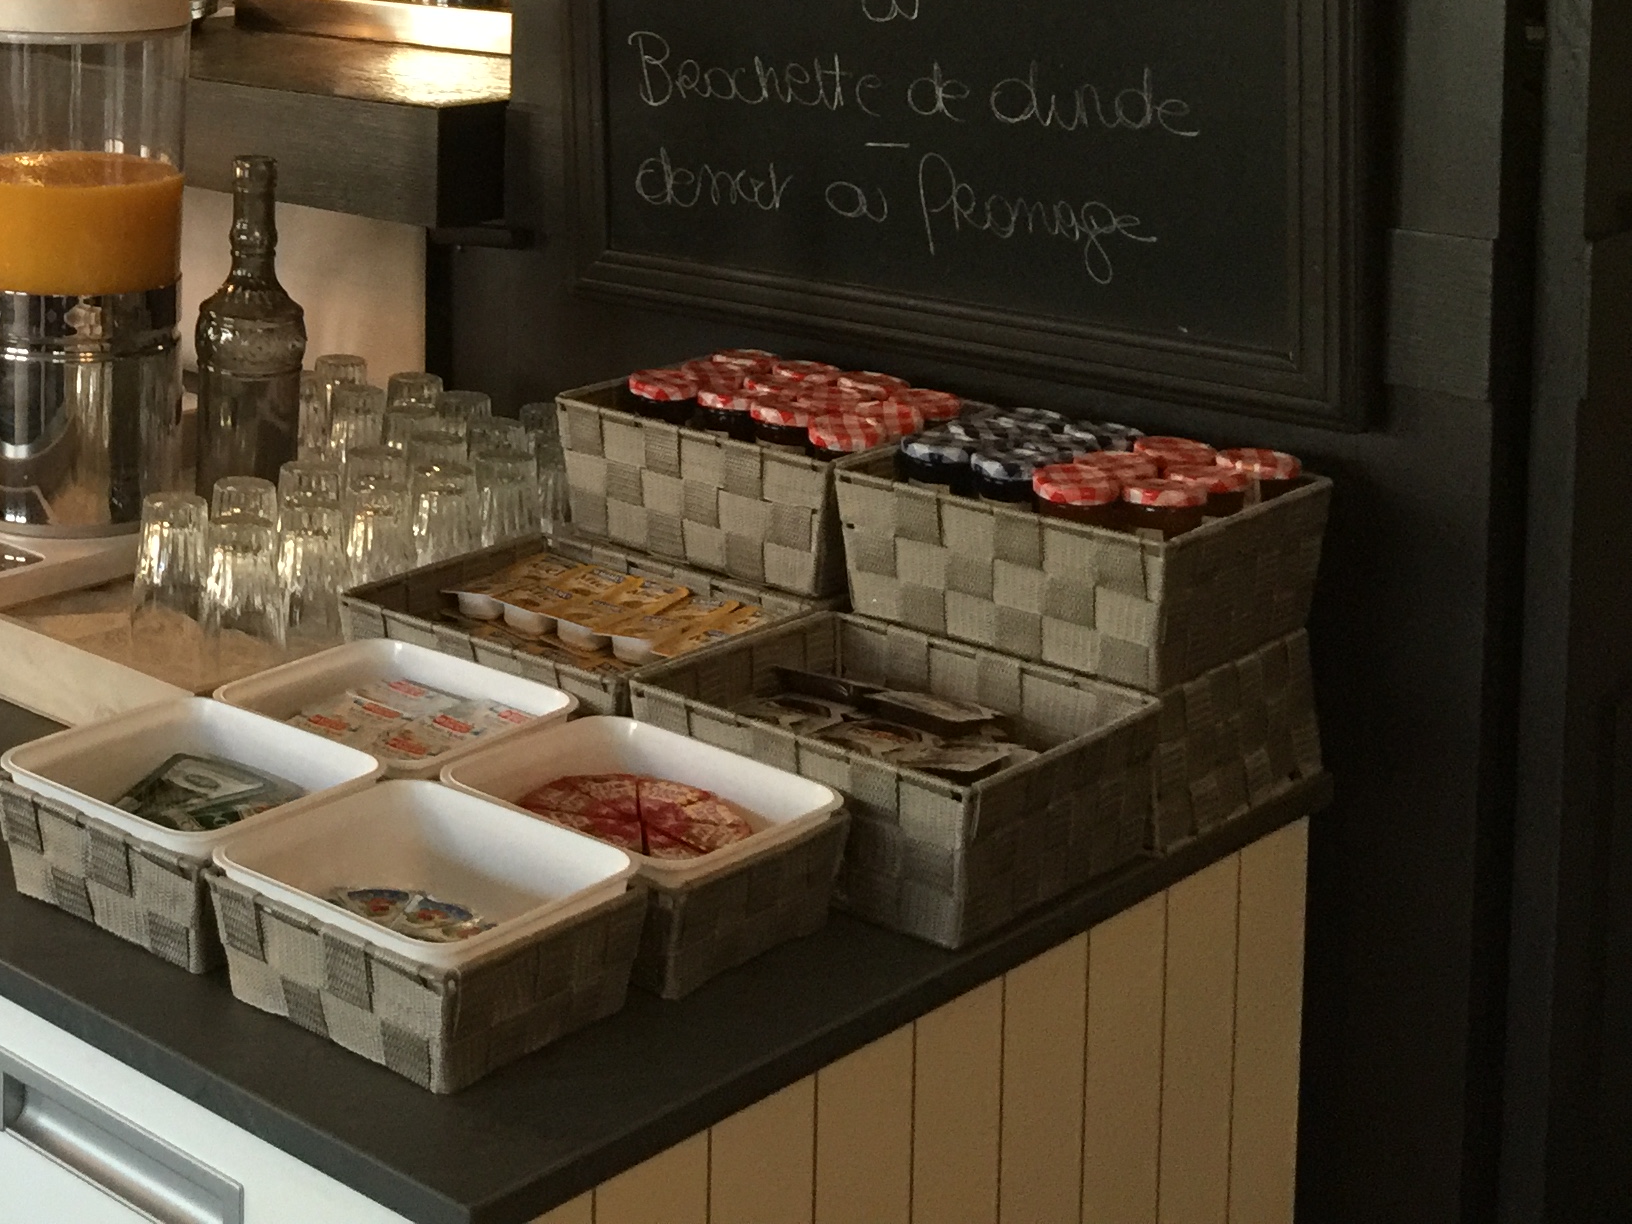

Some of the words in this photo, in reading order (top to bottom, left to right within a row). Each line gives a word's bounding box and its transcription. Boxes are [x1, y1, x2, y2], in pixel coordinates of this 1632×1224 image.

[628, 30, 880, 117] Brochette
[907, 62, 970, 122] de
[990, 59, 1200, 137] dinde
